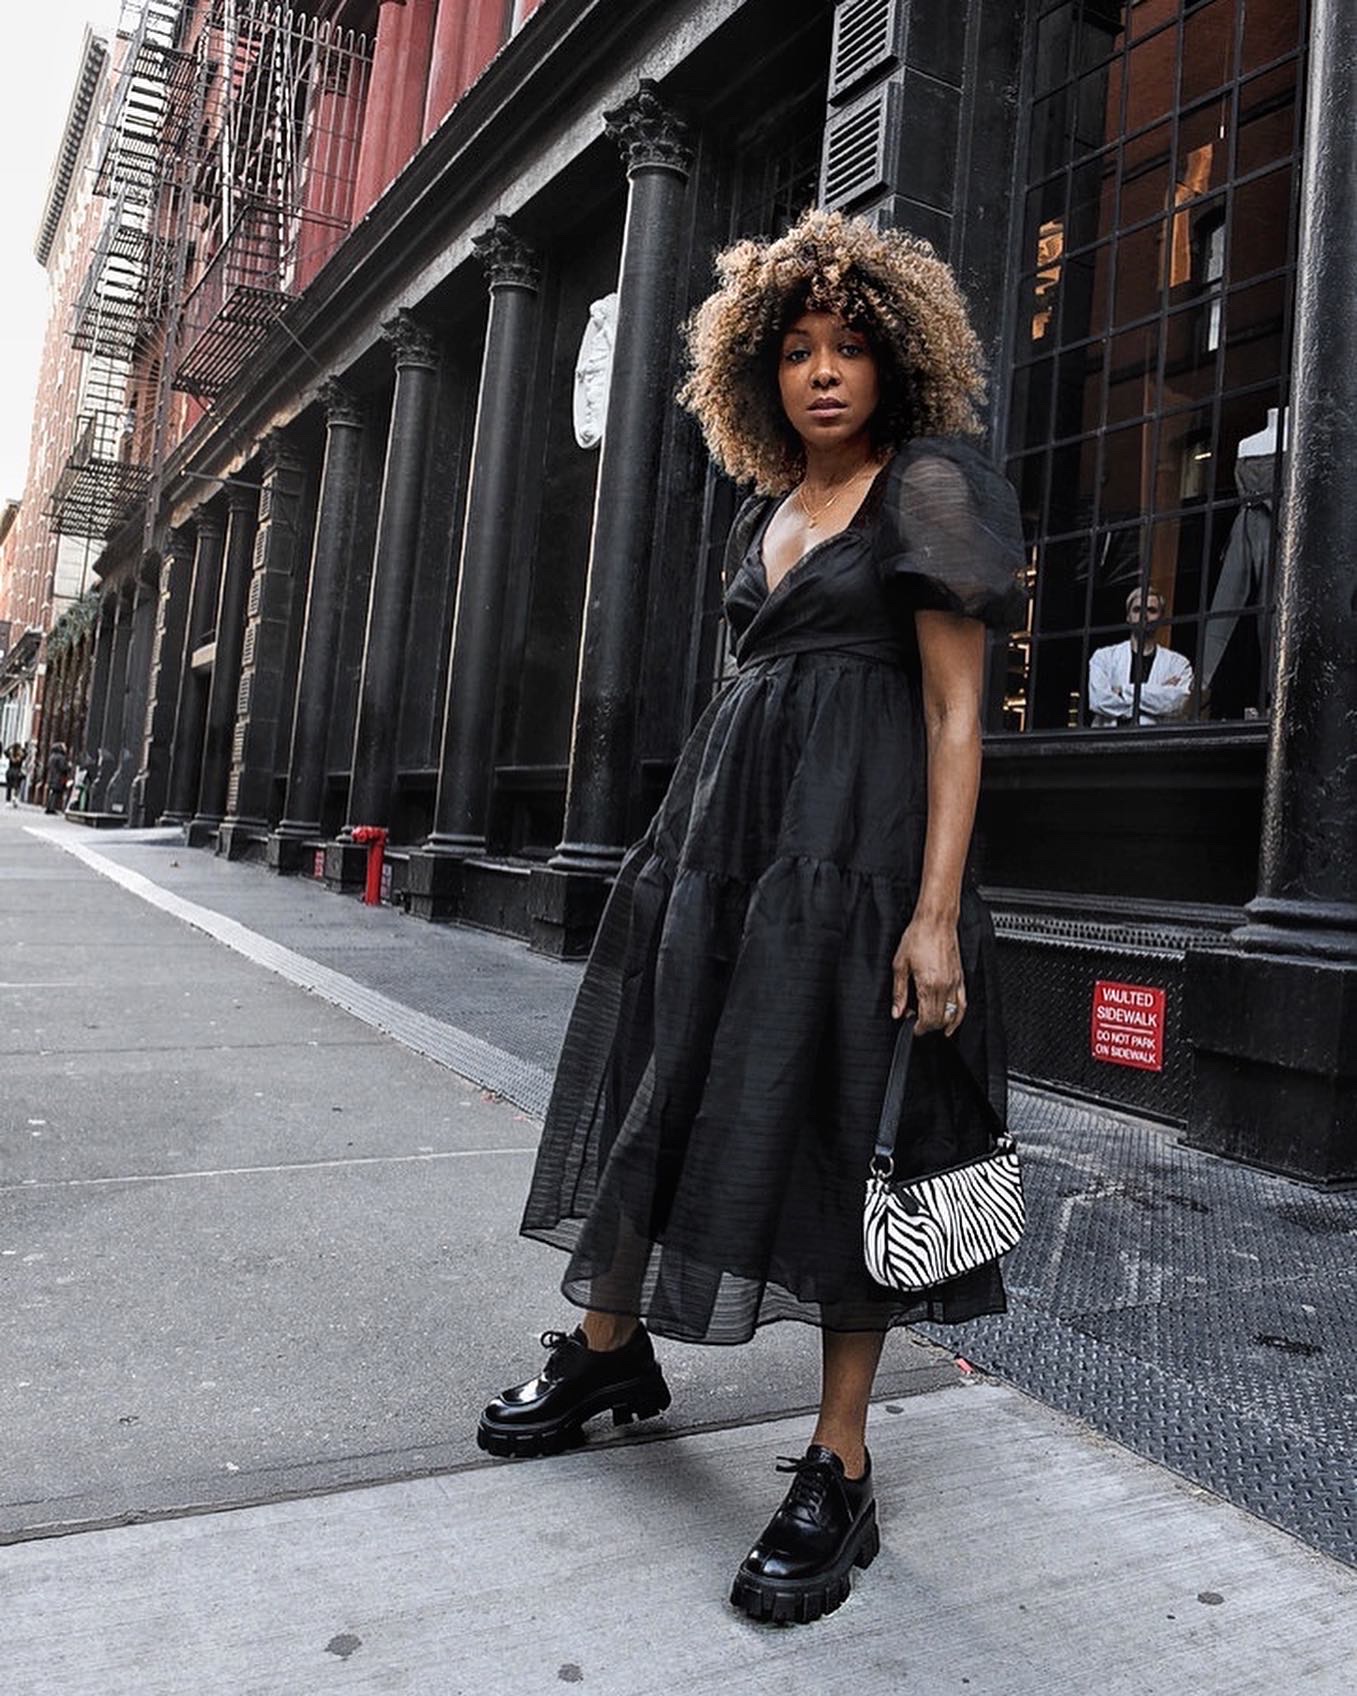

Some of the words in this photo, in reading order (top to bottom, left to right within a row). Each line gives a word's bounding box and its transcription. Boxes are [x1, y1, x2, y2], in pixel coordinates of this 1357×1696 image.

[1103, 988, 1154, 1007] VAULTED
[1097, 1005, 1157, 1027] SIDEWALK
[1096, 1030, 1110, 1041] DO
[1111, 1031, 1129, 1044] NOT
[1131, 1036, 1155, 1049] PARK
[1095, 1043, 1109, 1054] ON
[1111, 1046, 1156, 1064] SIDEWALK
